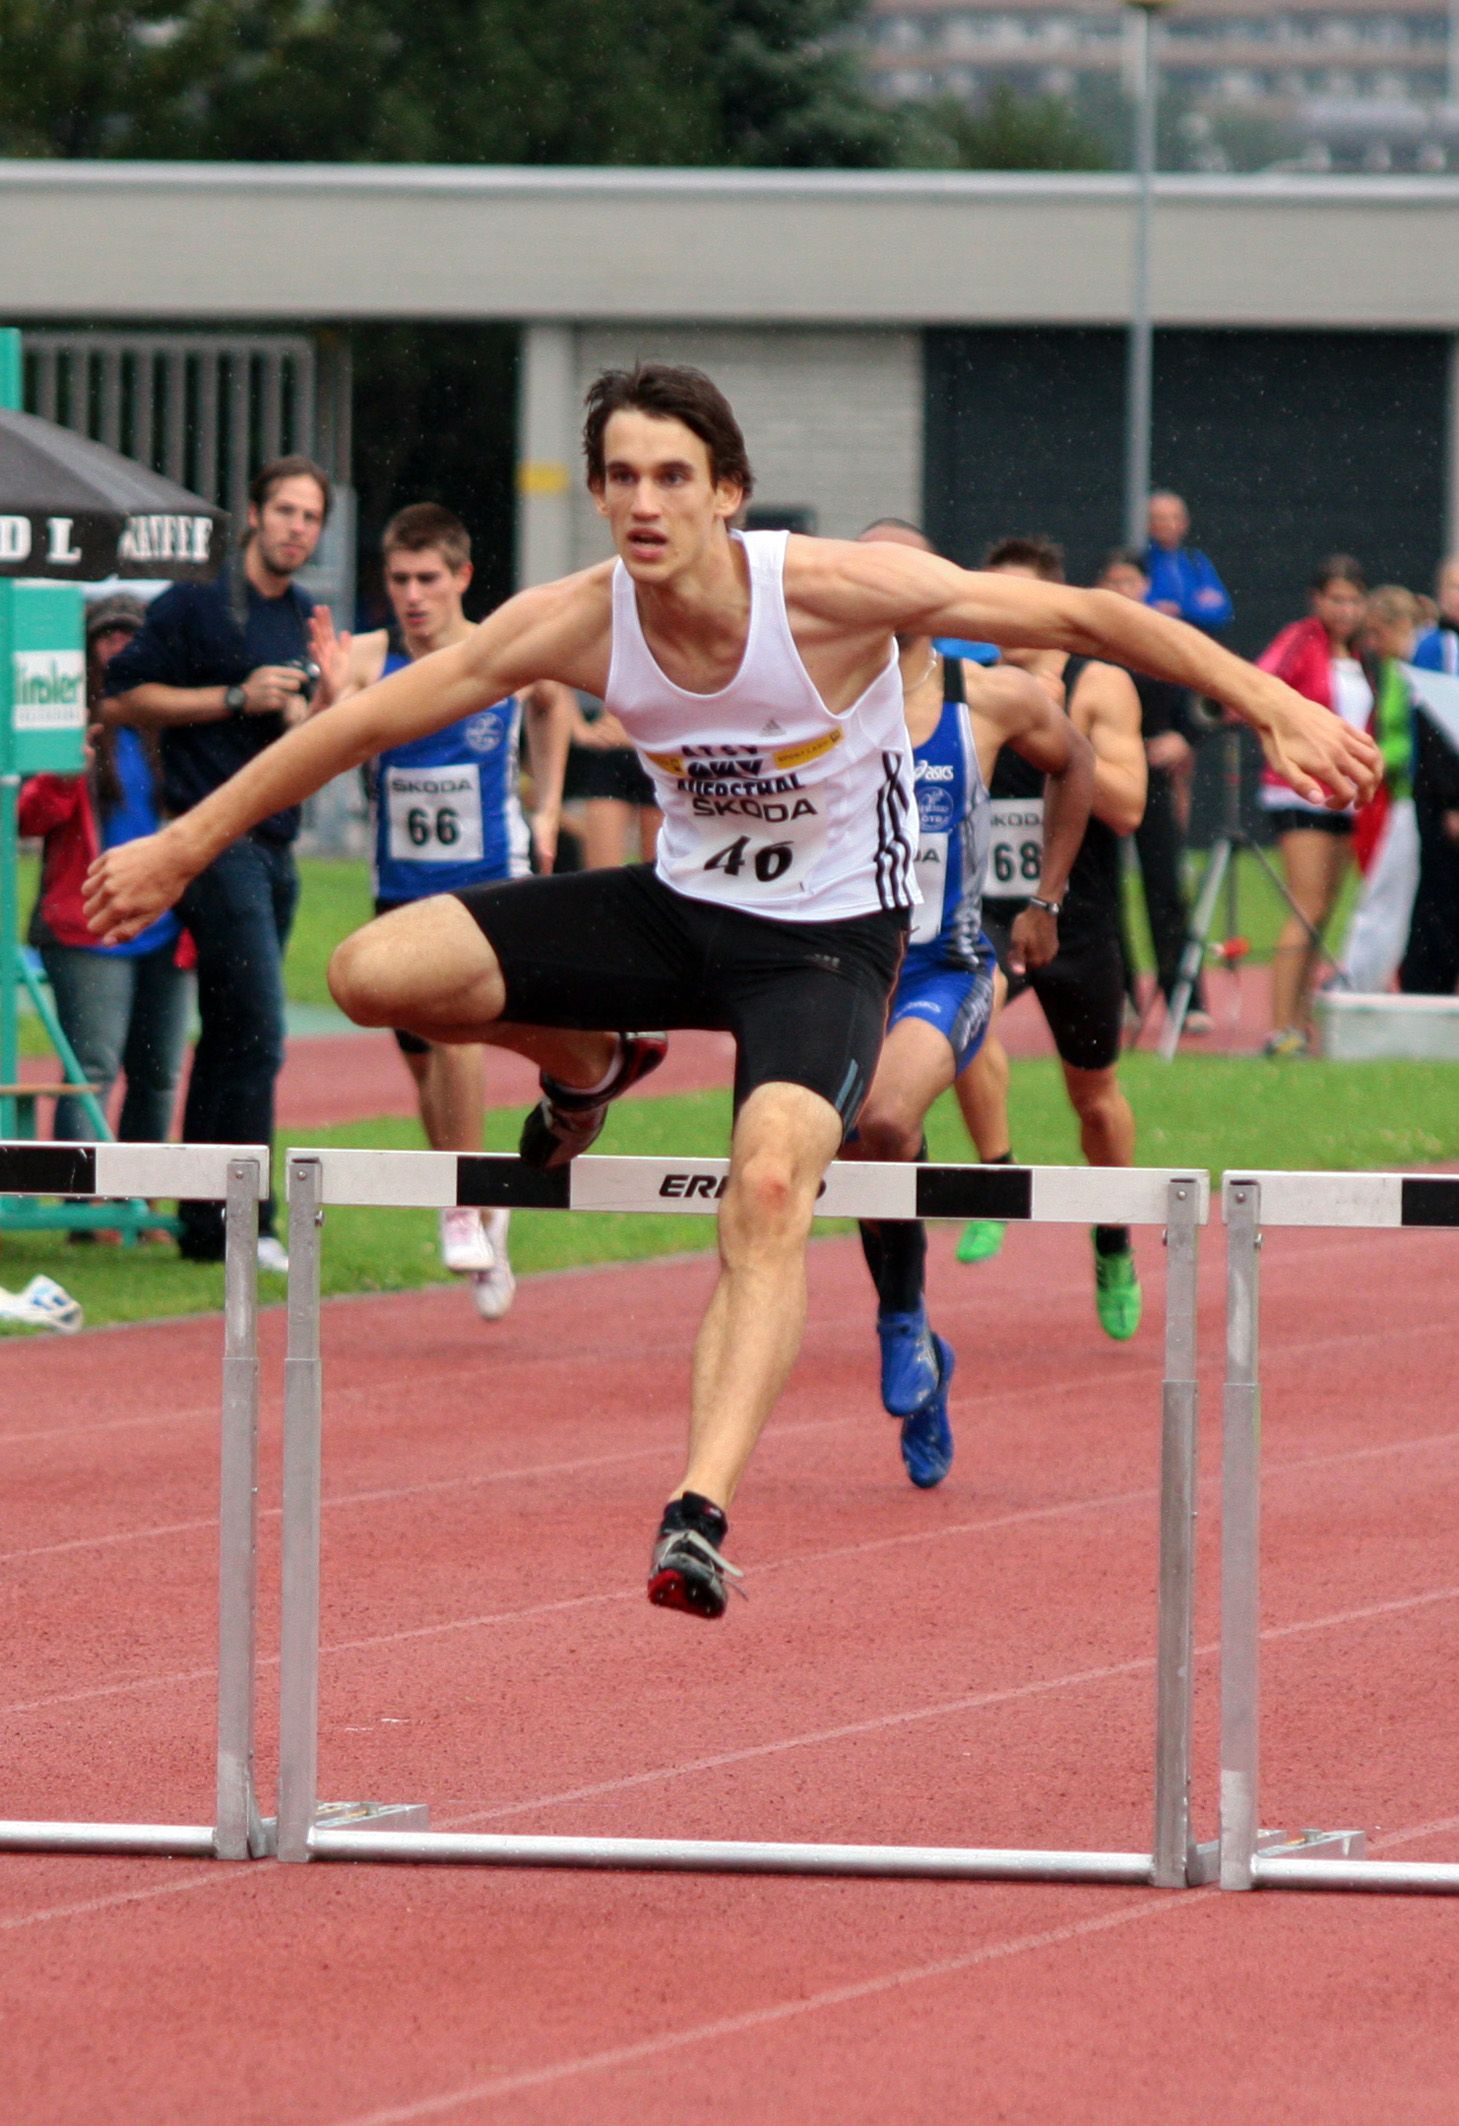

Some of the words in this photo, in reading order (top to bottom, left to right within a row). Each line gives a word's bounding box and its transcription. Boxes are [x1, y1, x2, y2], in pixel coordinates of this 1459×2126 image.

[407, 807, 460, 846] 66
[991, 812, 1044, 827] KOD
[993, 841, 1041, 882] 68
